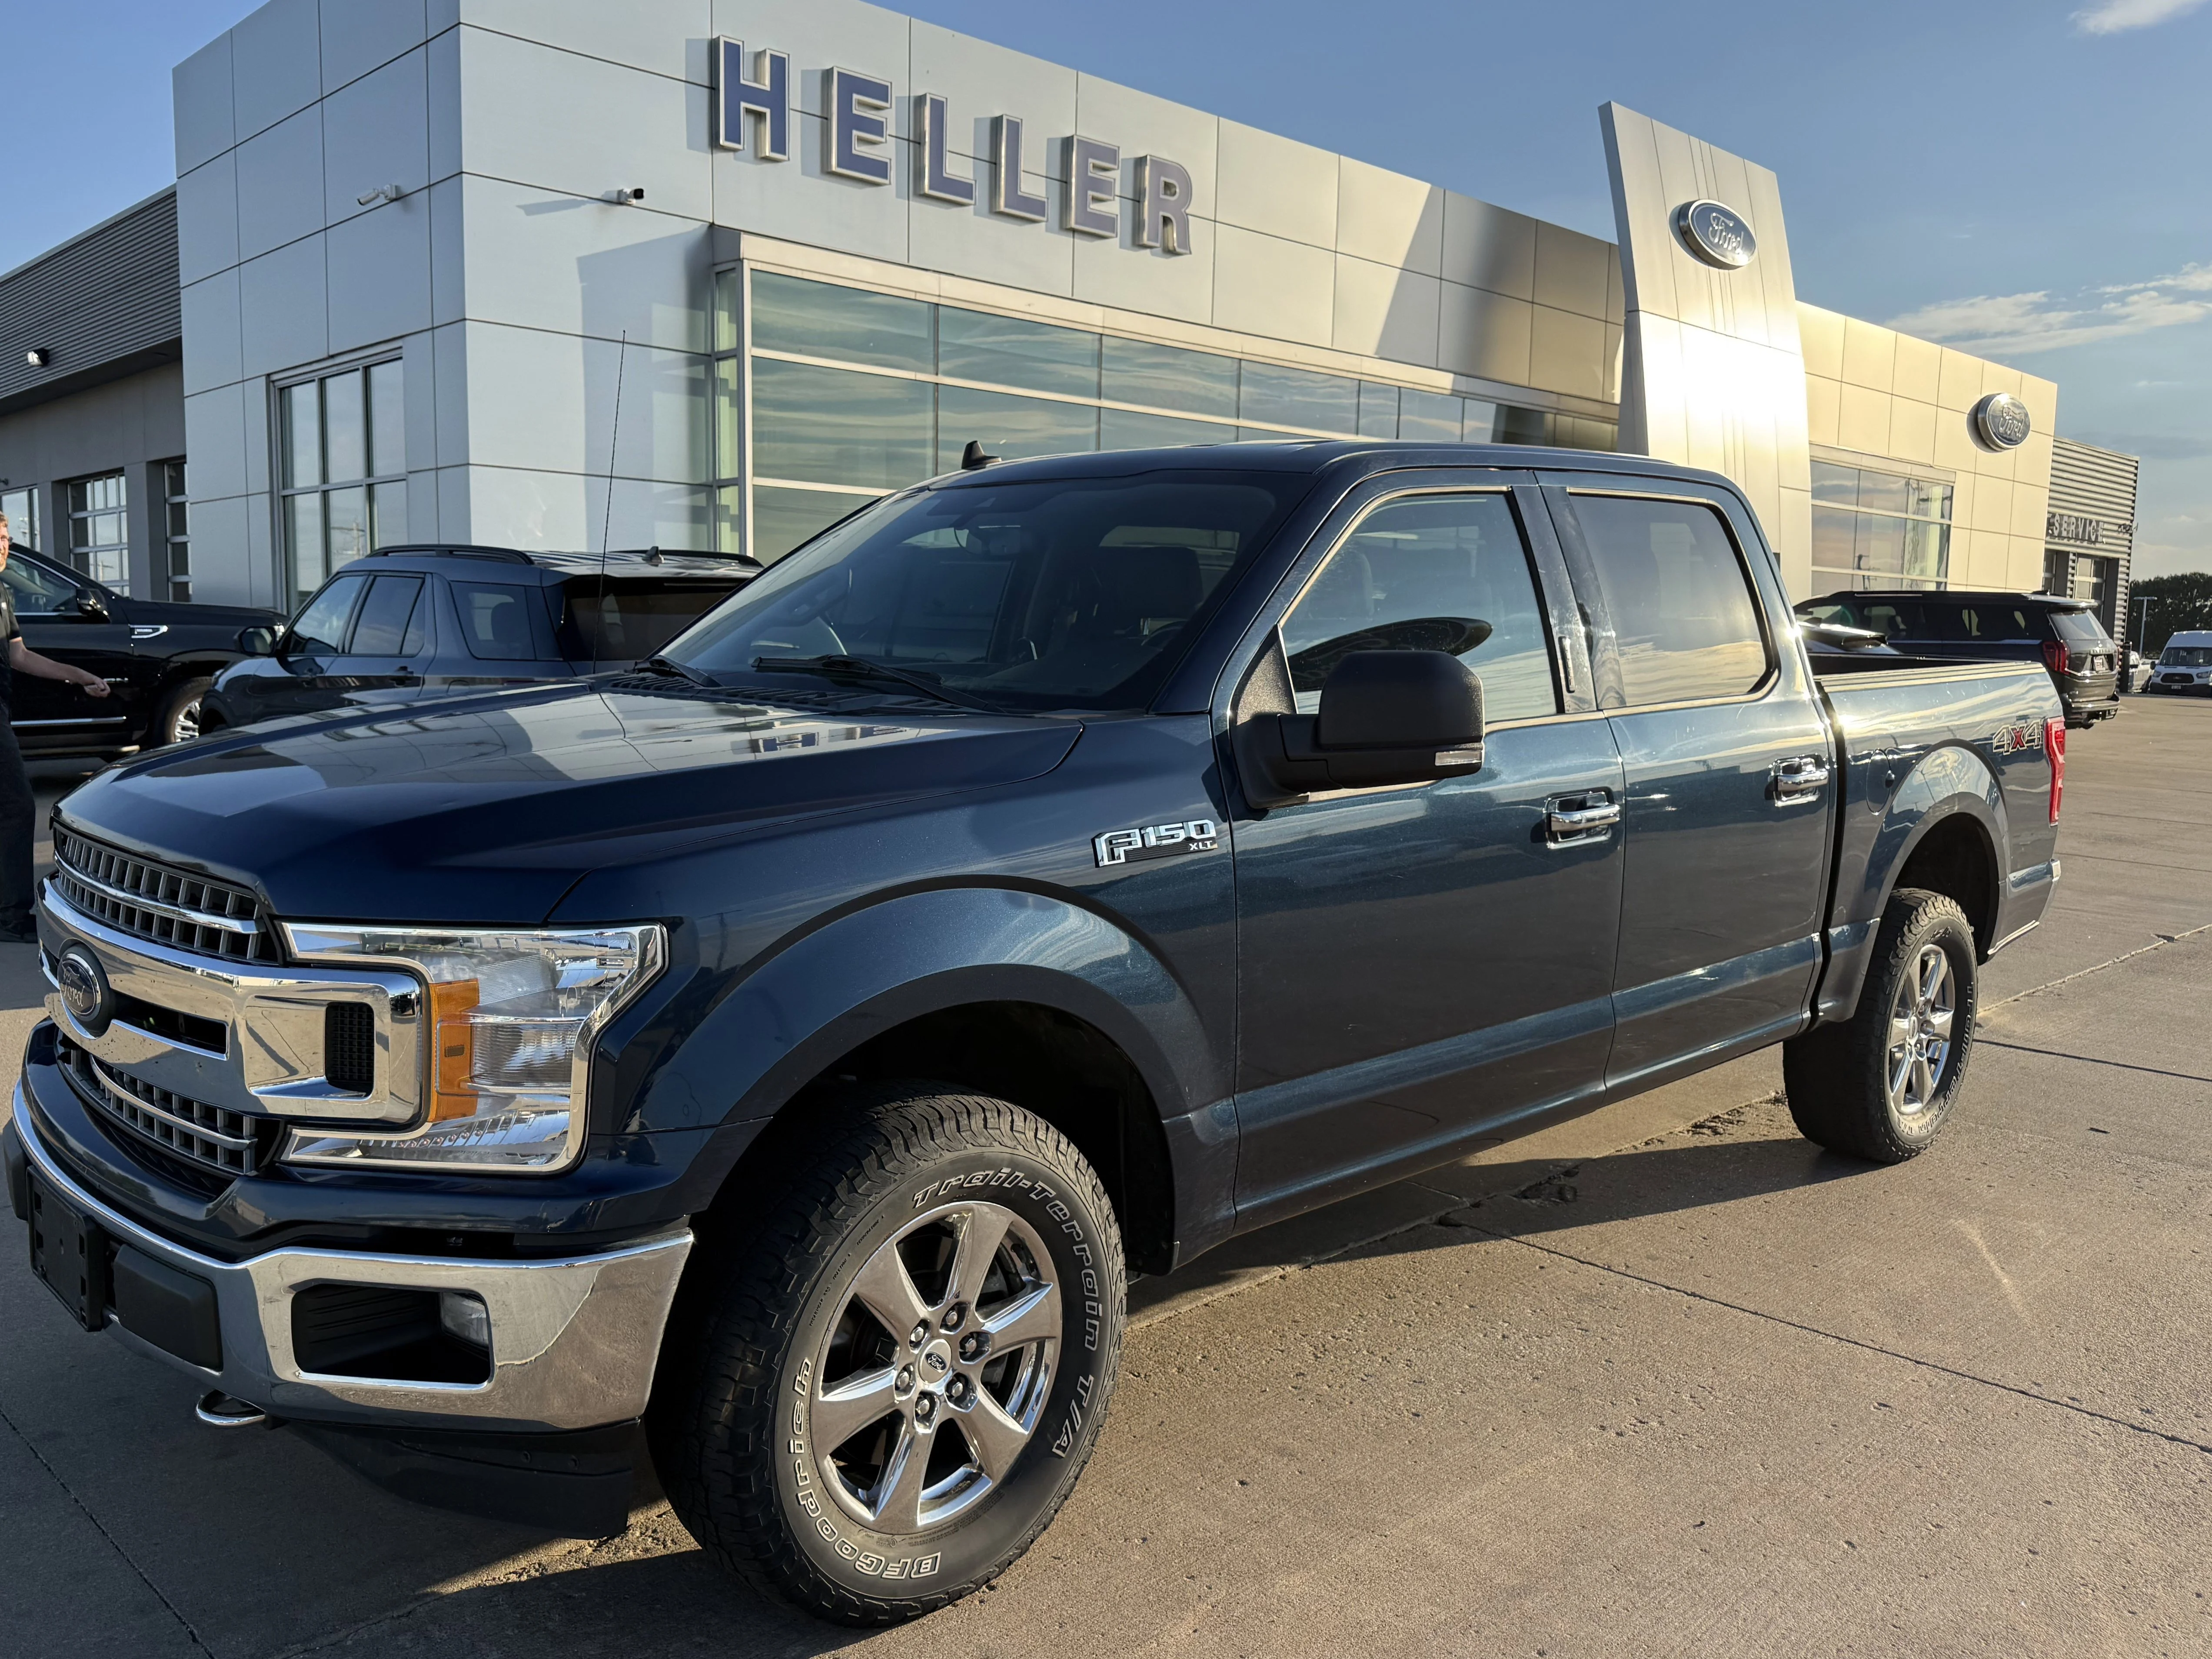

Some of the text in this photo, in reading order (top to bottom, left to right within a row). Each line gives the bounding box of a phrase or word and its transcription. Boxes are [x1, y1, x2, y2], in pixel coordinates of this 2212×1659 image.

[714, 35, 1193, 255] HELLER
[2053, 512, 2105, 542] SERVICE
[1189, 841, 1213, 851] XLT
[912, 1167, 1103, 1351] Trail-Terrain
[1052, 1374, 1094, 1458] T/A
[928, 1354, 944, 1370] Ford
[790, 1357, 941, 1579] BFGoodrich
